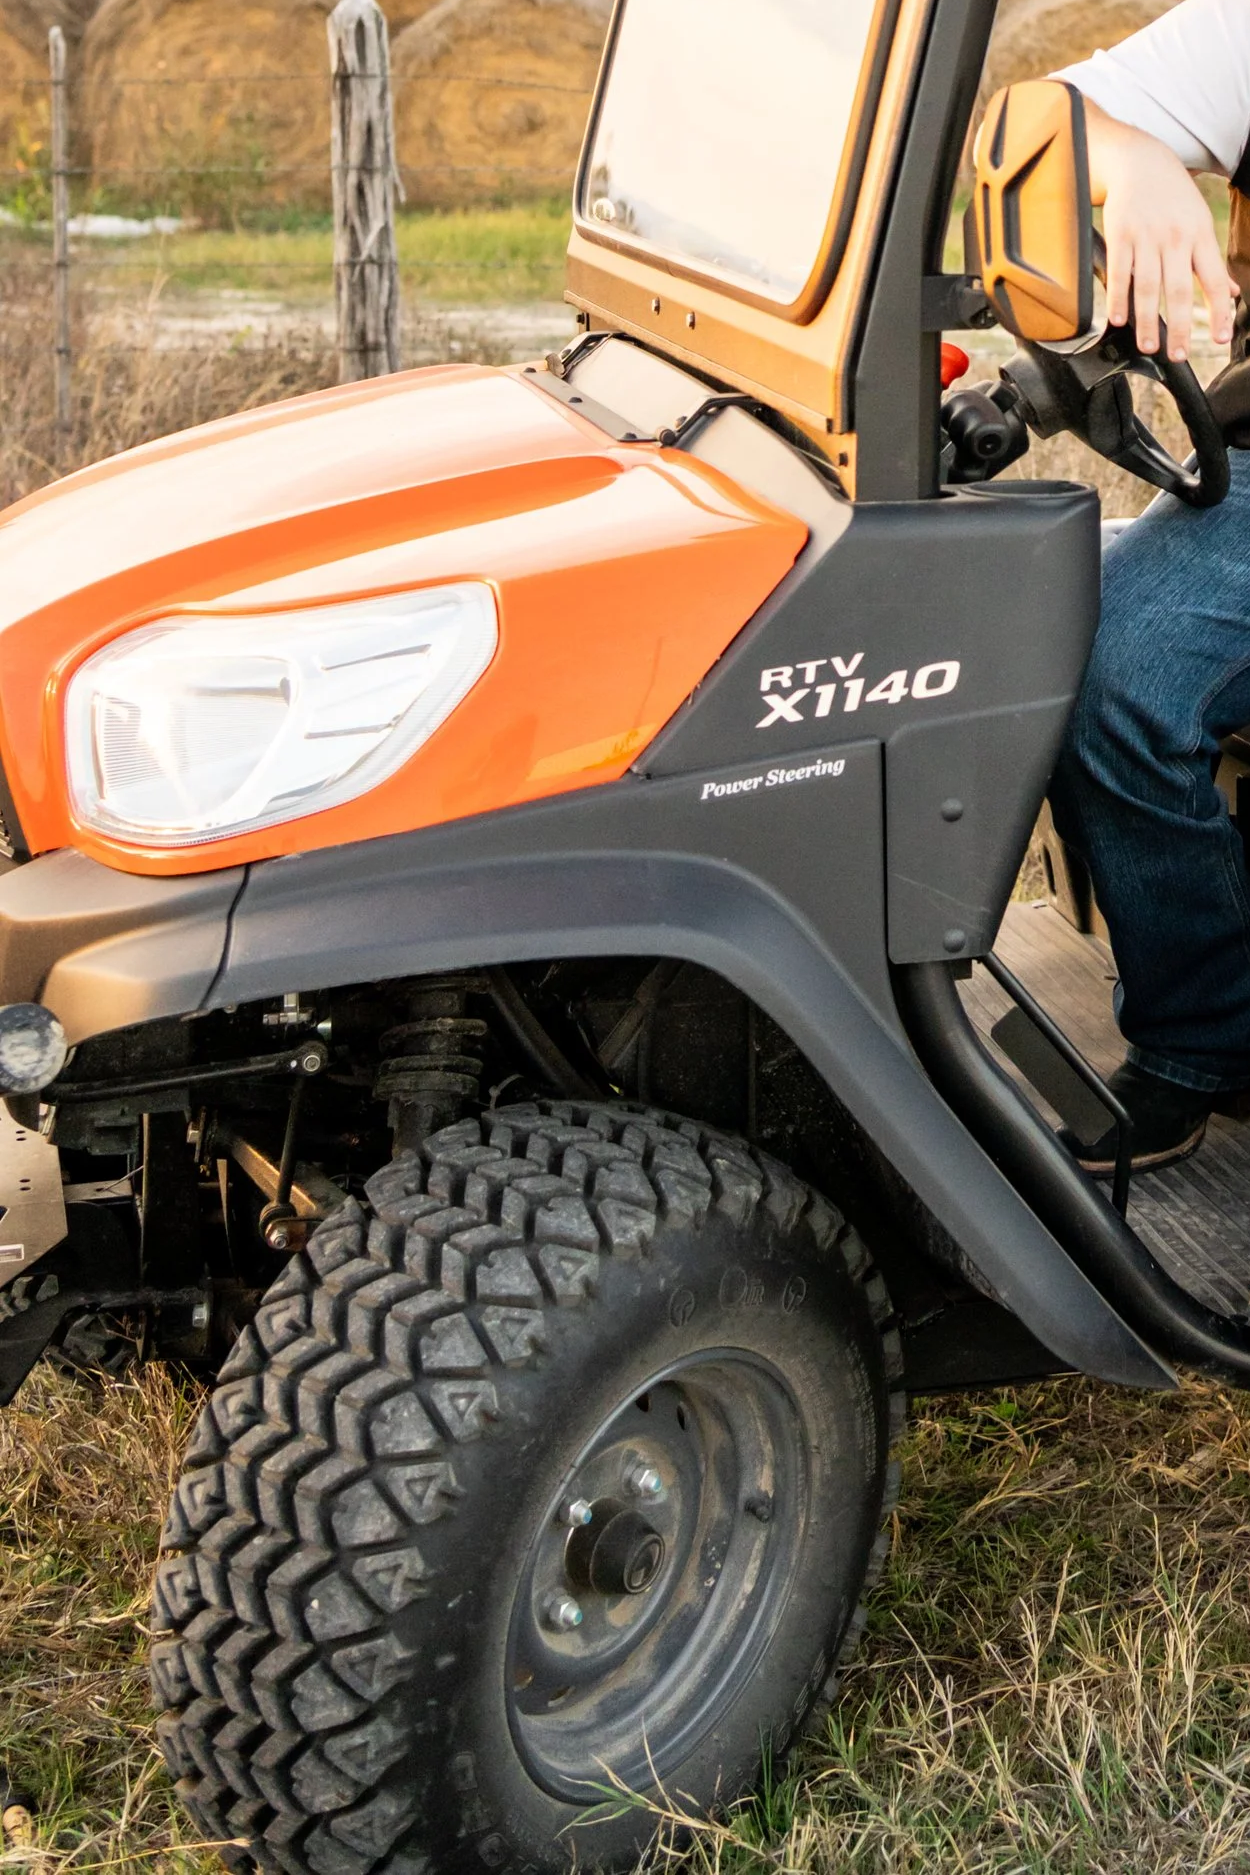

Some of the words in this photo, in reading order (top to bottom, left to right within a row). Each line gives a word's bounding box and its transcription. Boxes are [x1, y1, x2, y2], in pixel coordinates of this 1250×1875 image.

[760, 652, 865, 691] RTV
[755, 660, 961, 728] X1140
[700, 776, 764, 800] Power
[765, 758, 846, 787] Steering
